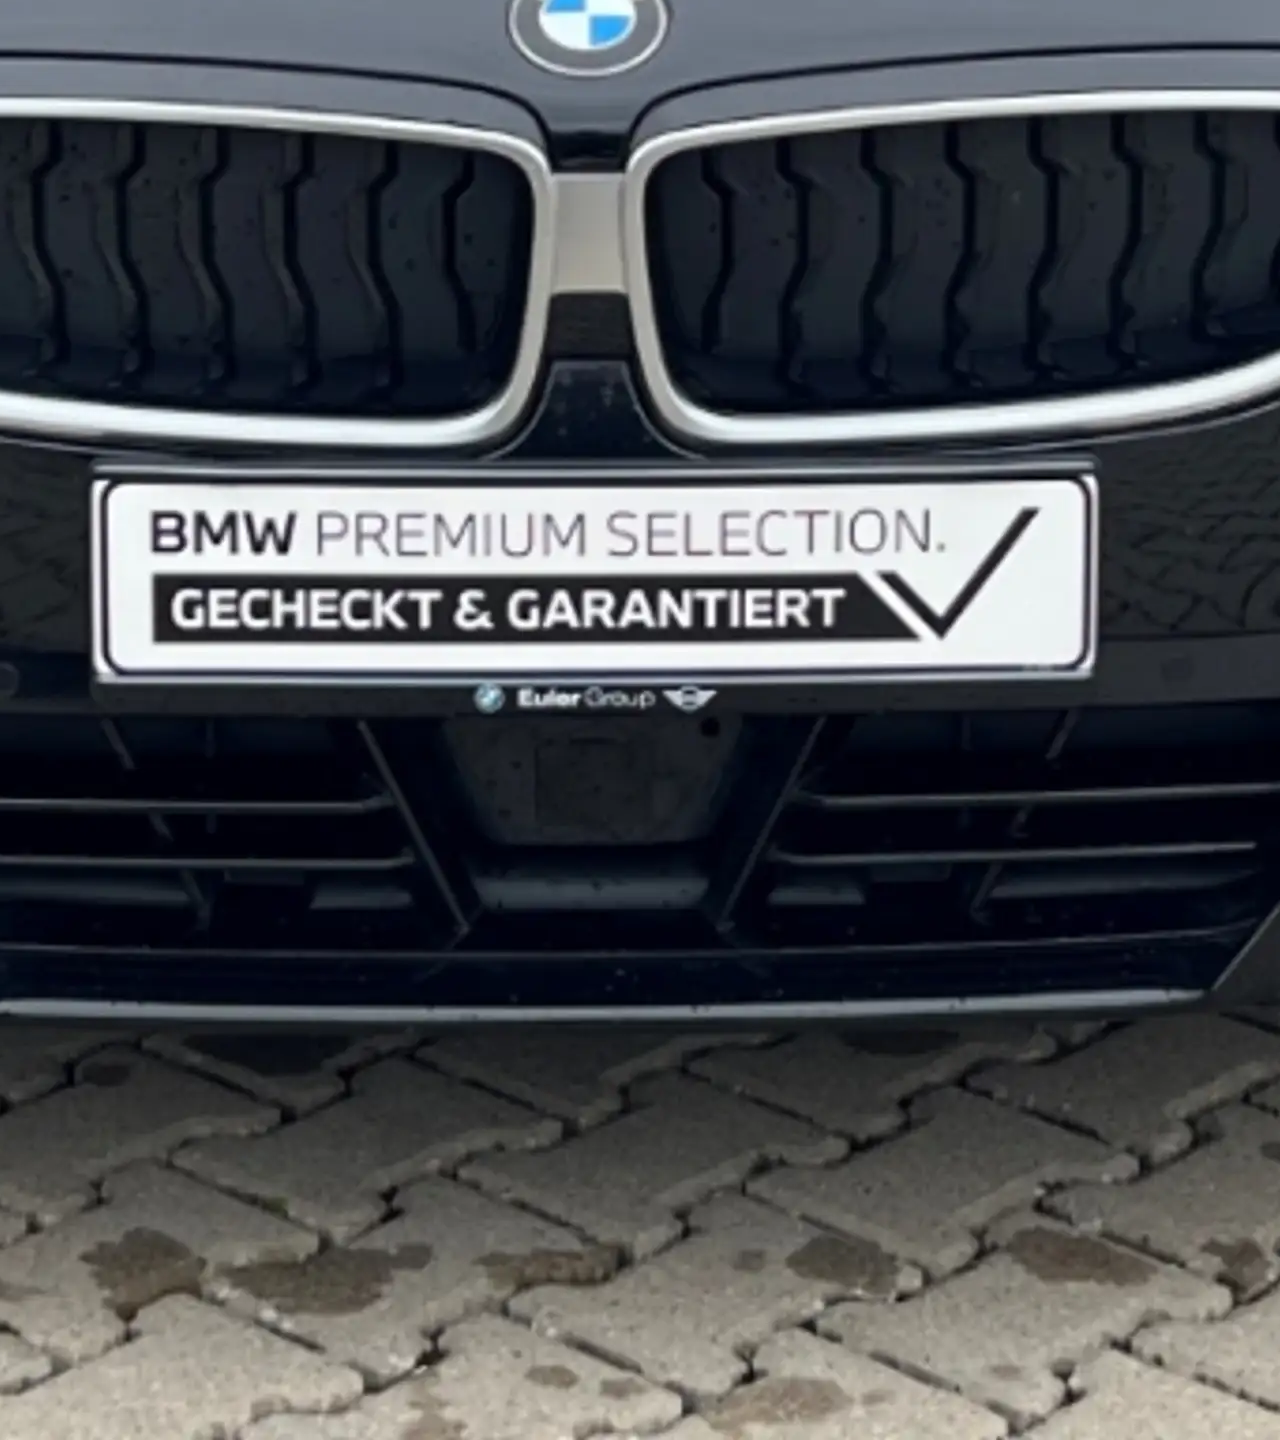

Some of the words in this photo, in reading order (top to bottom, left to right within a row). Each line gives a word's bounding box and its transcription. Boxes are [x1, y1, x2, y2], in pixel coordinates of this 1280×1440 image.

[150, 510, 296, 555] BMW
[316, 511, 587, 558] PREMIUM
[606, 507, 946, 557] SELECTION.
[170, 588, 443, 630] GECHECKT
[452, 588, 495, 630] &
[507, 587, 847, 630] GARANTIERT
